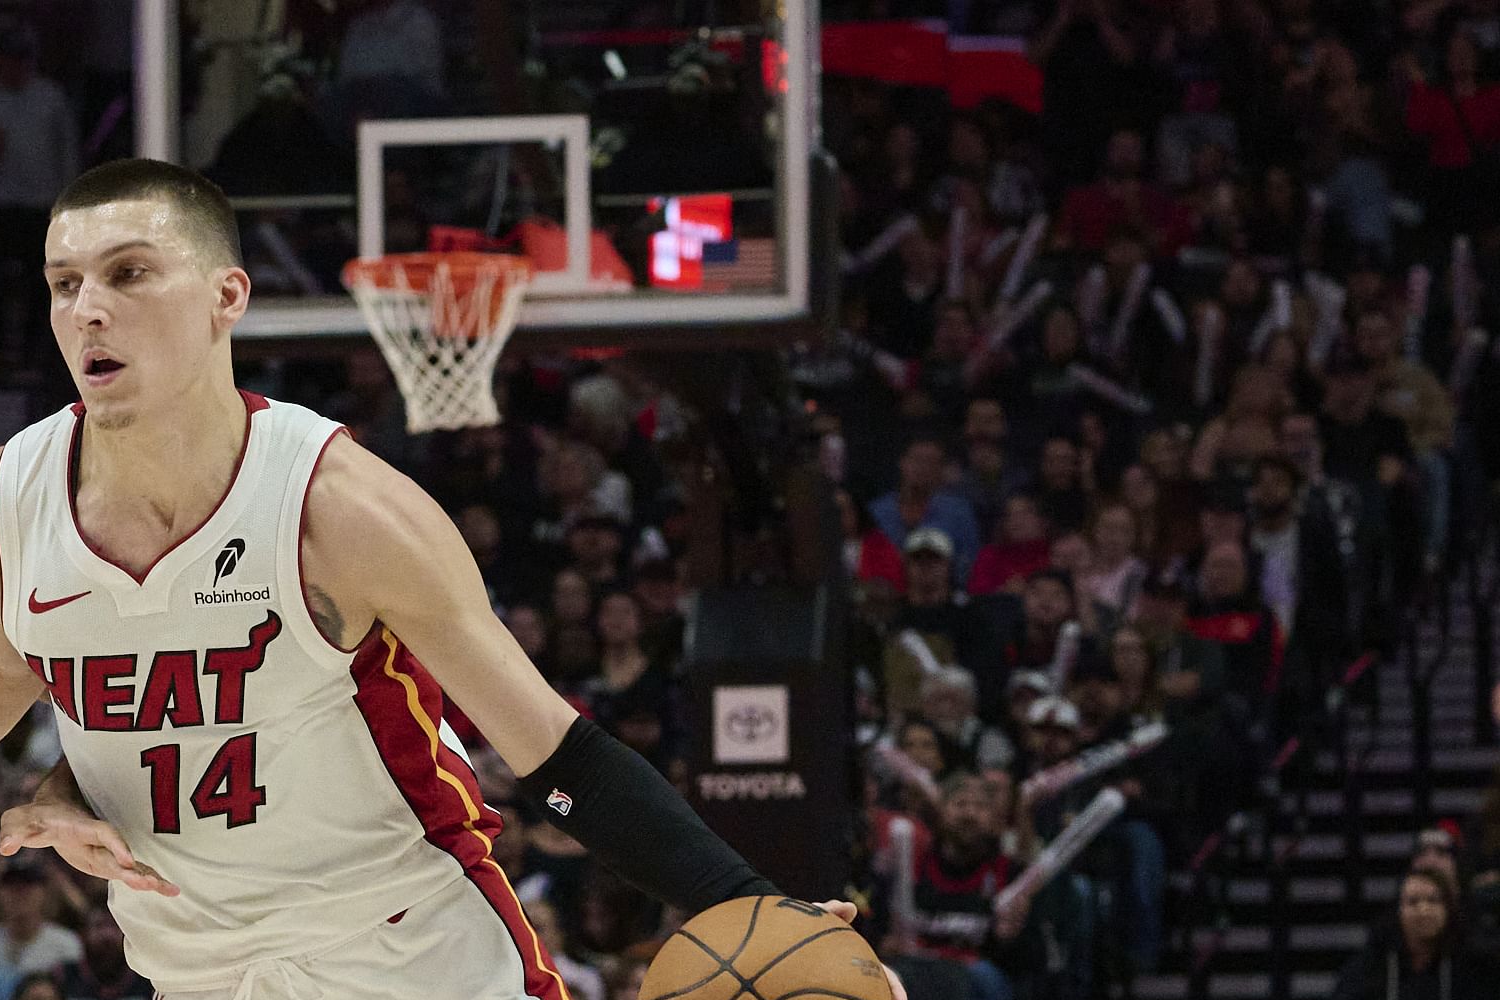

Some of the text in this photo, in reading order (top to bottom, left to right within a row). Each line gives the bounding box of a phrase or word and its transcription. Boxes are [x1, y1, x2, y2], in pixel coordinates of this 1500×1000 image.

[194, 586, 271, 606] Robinhood
[23, 608, 283, 732] HEAT
[140, 731, 266, 835] 14
[698, 772, 806, 799] TOYOTA
